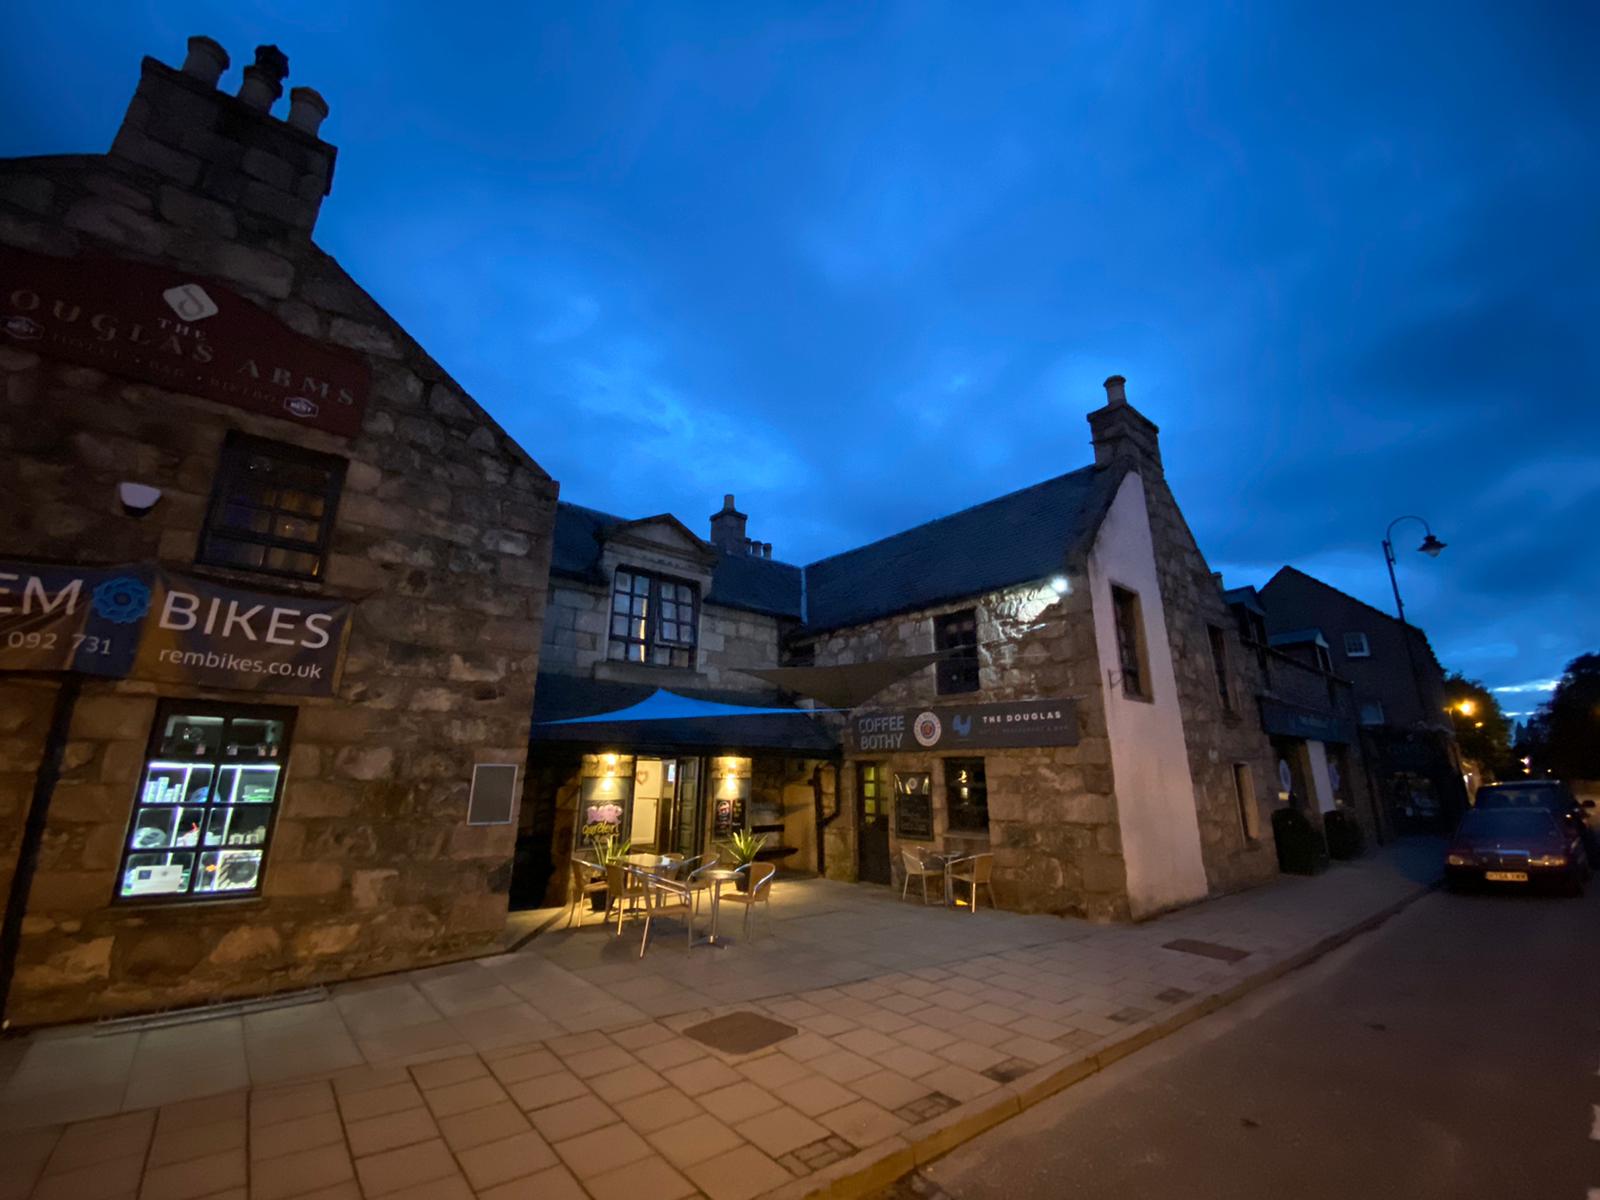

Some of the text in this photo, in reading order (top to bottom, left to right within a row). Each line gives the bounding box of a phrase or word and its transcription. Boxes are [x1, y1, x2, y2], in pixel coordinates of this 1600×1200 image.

[158, 317, 207, 340] THE
[238, 359, 354, 406] ARMS
[158, 589, 334, 650] BIKES
[7, 630, 112, 657] 092 731
[158, 647, 323, 680] rembikes.co.uk
[858, 714, 905, 734] COFFEE
[982, 710, 1062, 724] THE DOUGLAS
[860, 733, 904, 751] BOTHY
